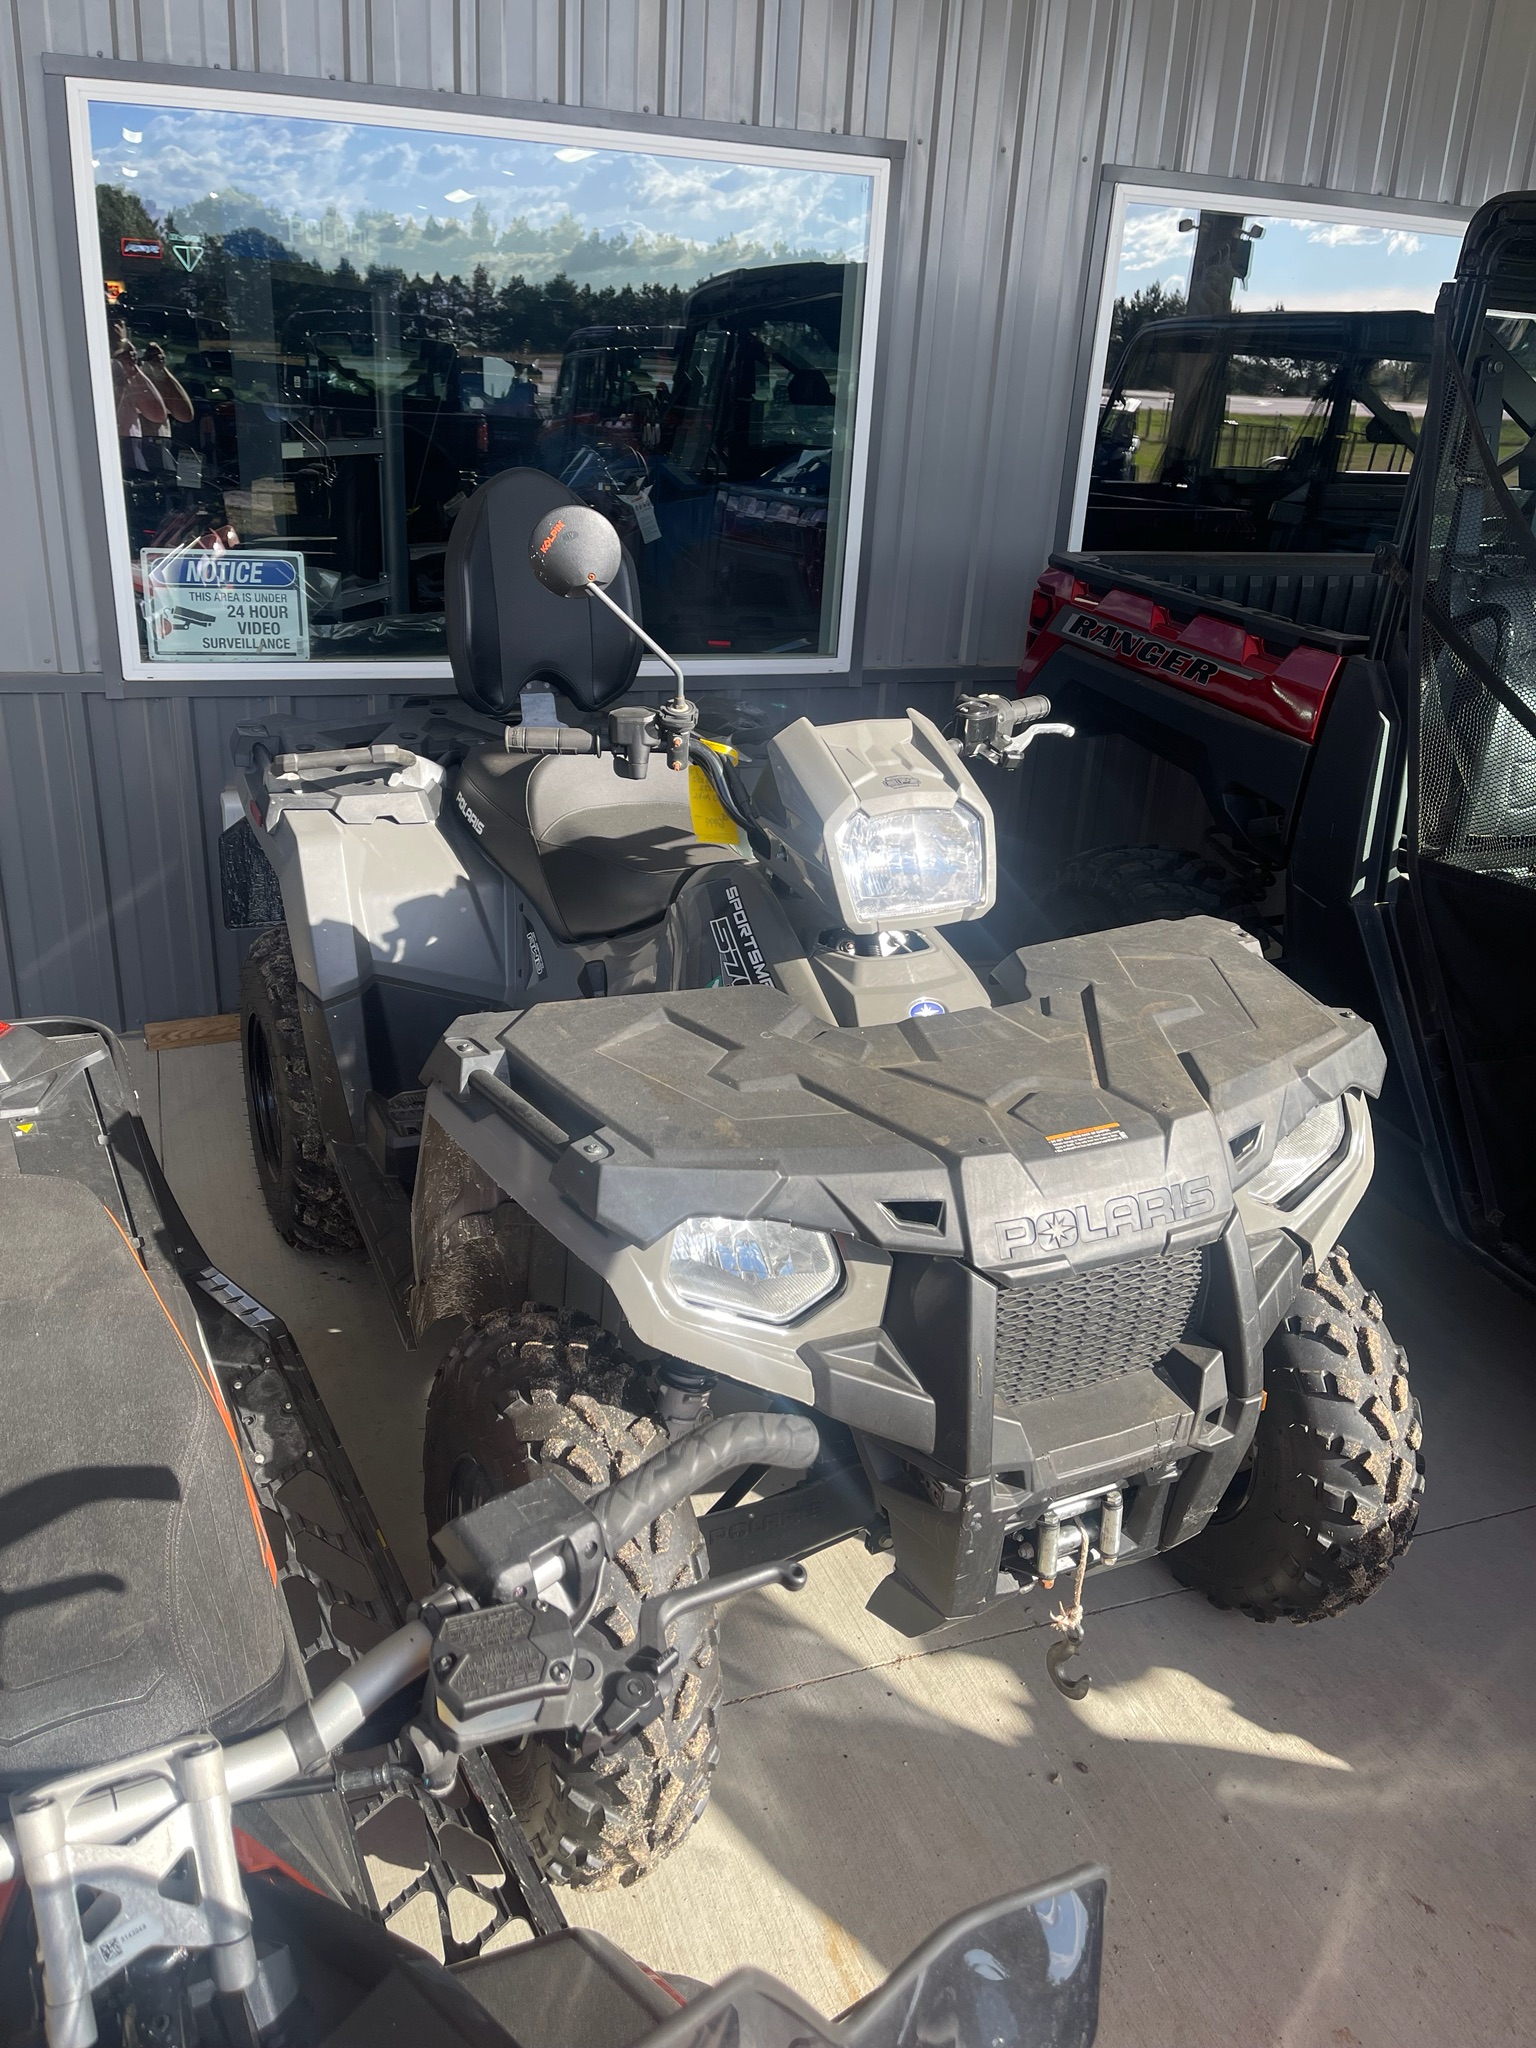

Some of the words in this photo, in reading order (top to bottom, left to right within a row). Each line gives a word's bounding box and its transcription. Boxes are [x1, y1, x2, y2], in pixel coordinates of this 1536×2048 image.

[540, 519, 566, 554] KOLPIN
[186, 560, 264, 584] NOTICE
[189, 591, 211, 602] THIS
[214, 592, 240, 602] AREA
[242, 593, 251, 603] IS
[254, 593, 288, 603] UNDER
[226, 605, 245, 618] 24
[249, 605, 289, 619] HOUR
[237, 621, 281, 635] VIDEO
[202, 637, 291, 649] SURVEILLANCE
[1068, 614, 1219, 687] RANGER
[456, 790, 485, 835] POLARIS
[994, 1175, 1215, 1260] POLARIS
